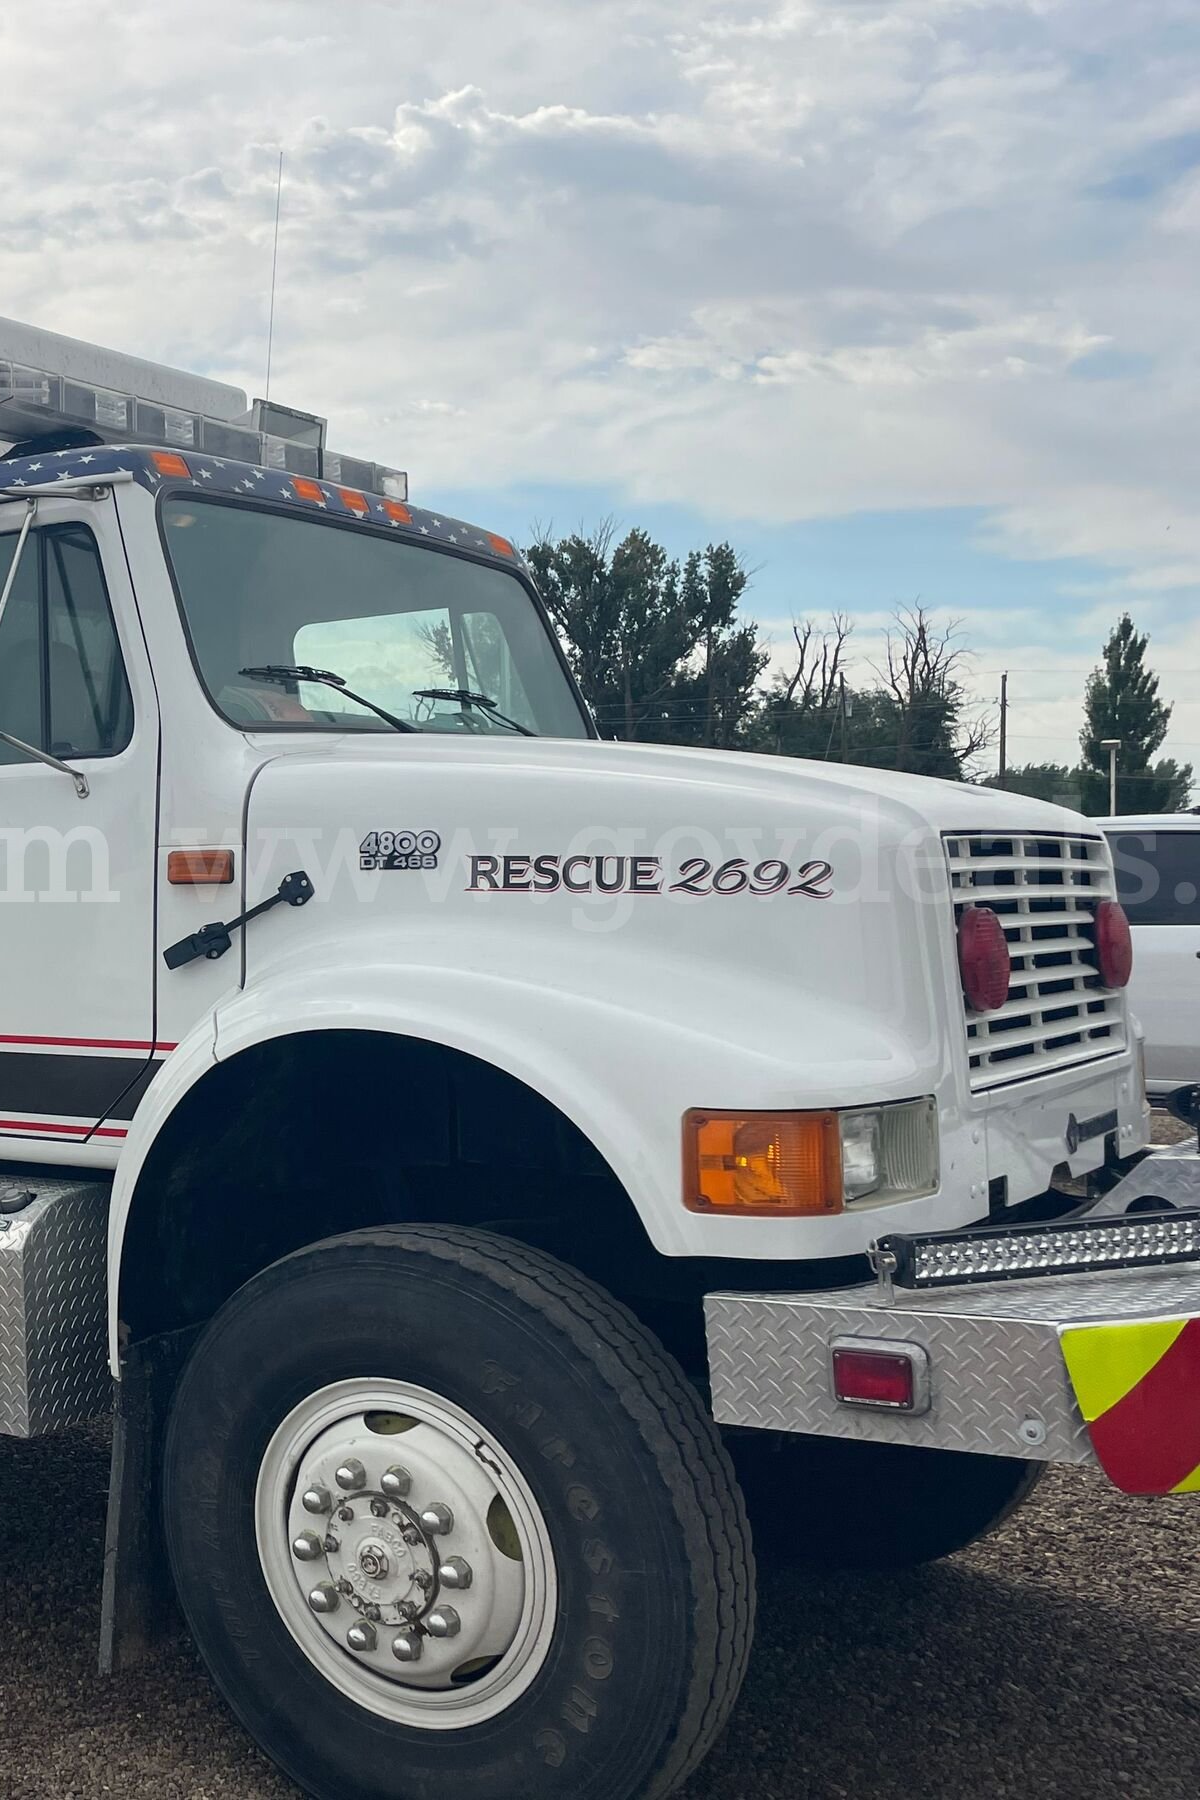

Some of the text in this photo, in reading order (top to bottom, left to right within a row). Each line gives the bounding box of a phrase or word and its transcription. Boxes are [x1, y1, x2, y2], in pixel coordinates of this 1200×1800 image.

[359, 830, 441, 856] 4800
[360, 855, 438, 870] DT 466
[464, 854, 834, 899] RESCUE 2692
